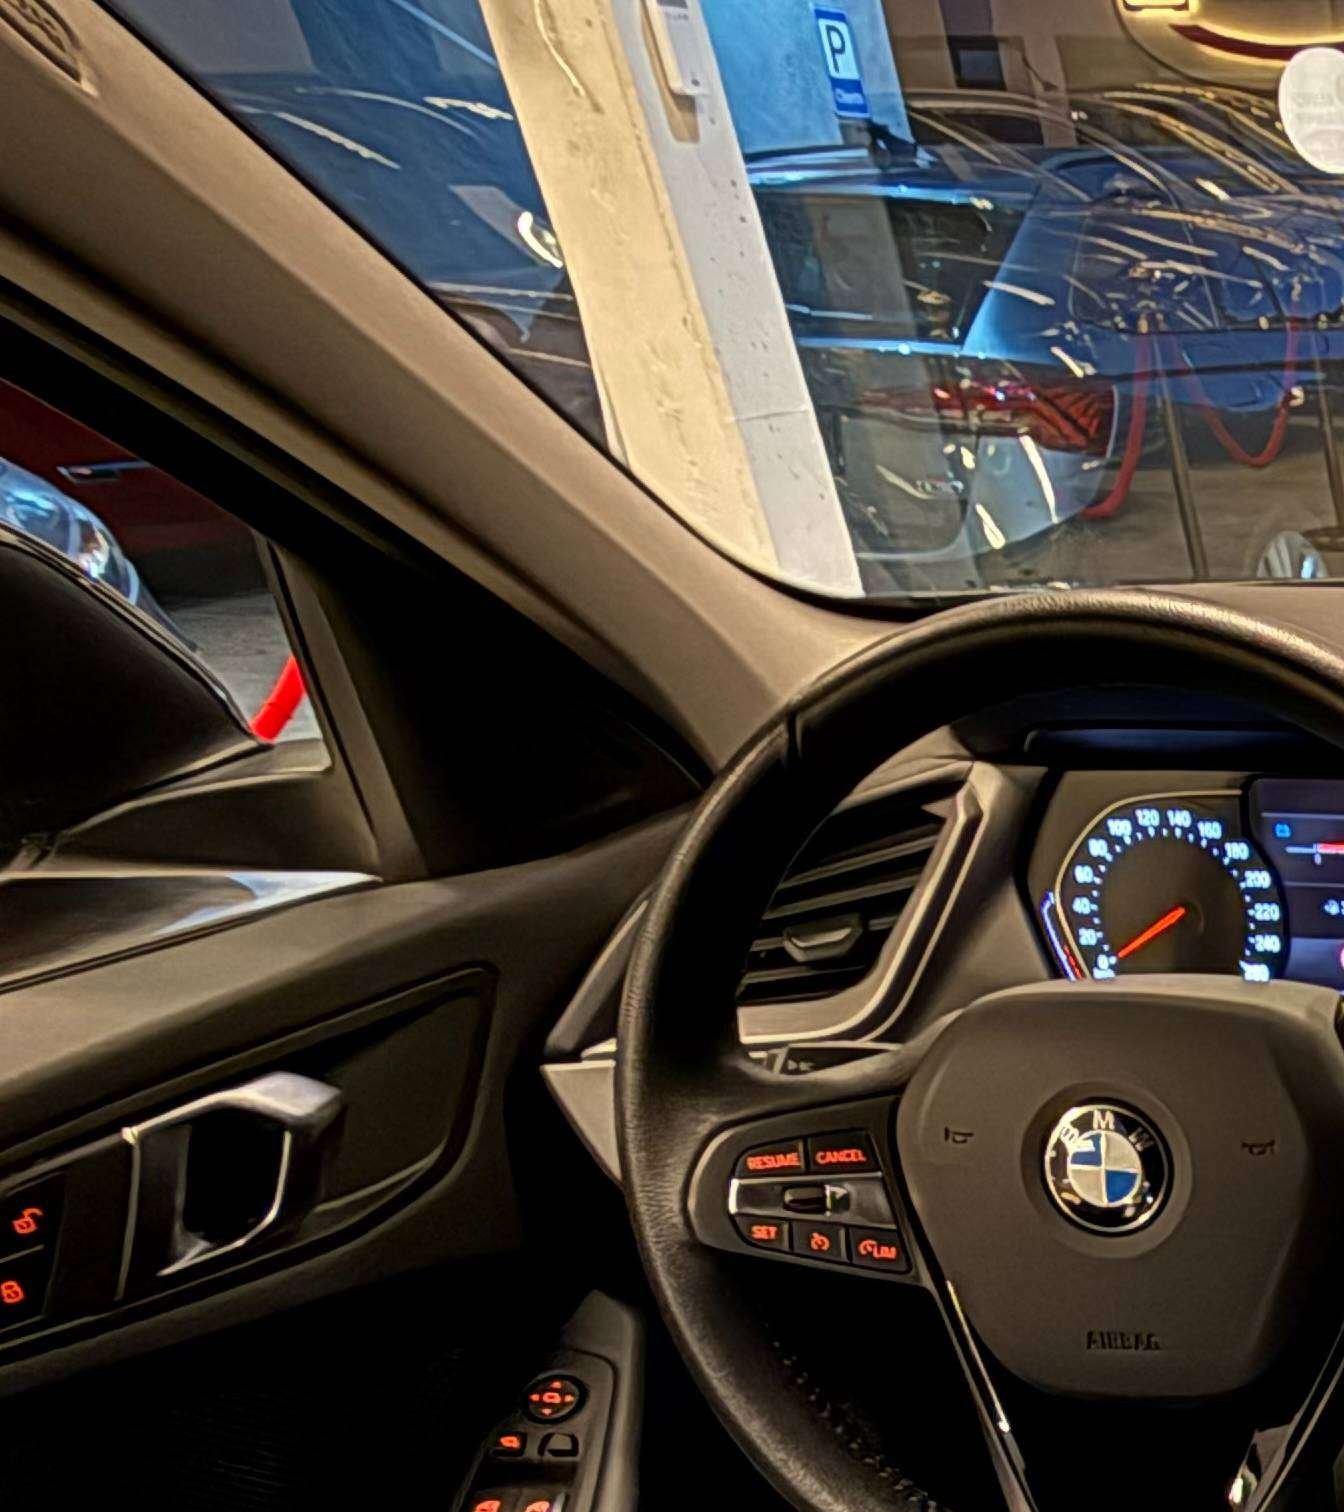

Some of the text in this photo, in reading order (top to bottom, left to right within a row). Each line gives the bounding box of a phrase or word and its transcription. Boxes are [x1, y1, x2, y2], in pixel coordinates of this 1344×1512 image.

[825, 24, 846, 73] P
[1136, 809, 1159, 826] 120
[1167, 810, 1191, 827] 140
[1107, 819, 1131, 836] 100
[1254, 903, 1279, 921] 220
[1079, 928, 1096, 946] 20
[1254, 935, 1280, 953] 240
[1059, 1110, 1154, 1151] BMW
[747, 1152, 801, 1170] RESUME
[816, 1149, 866, 1165] CANCEL
[752, 1225, 778, 1240] SET
